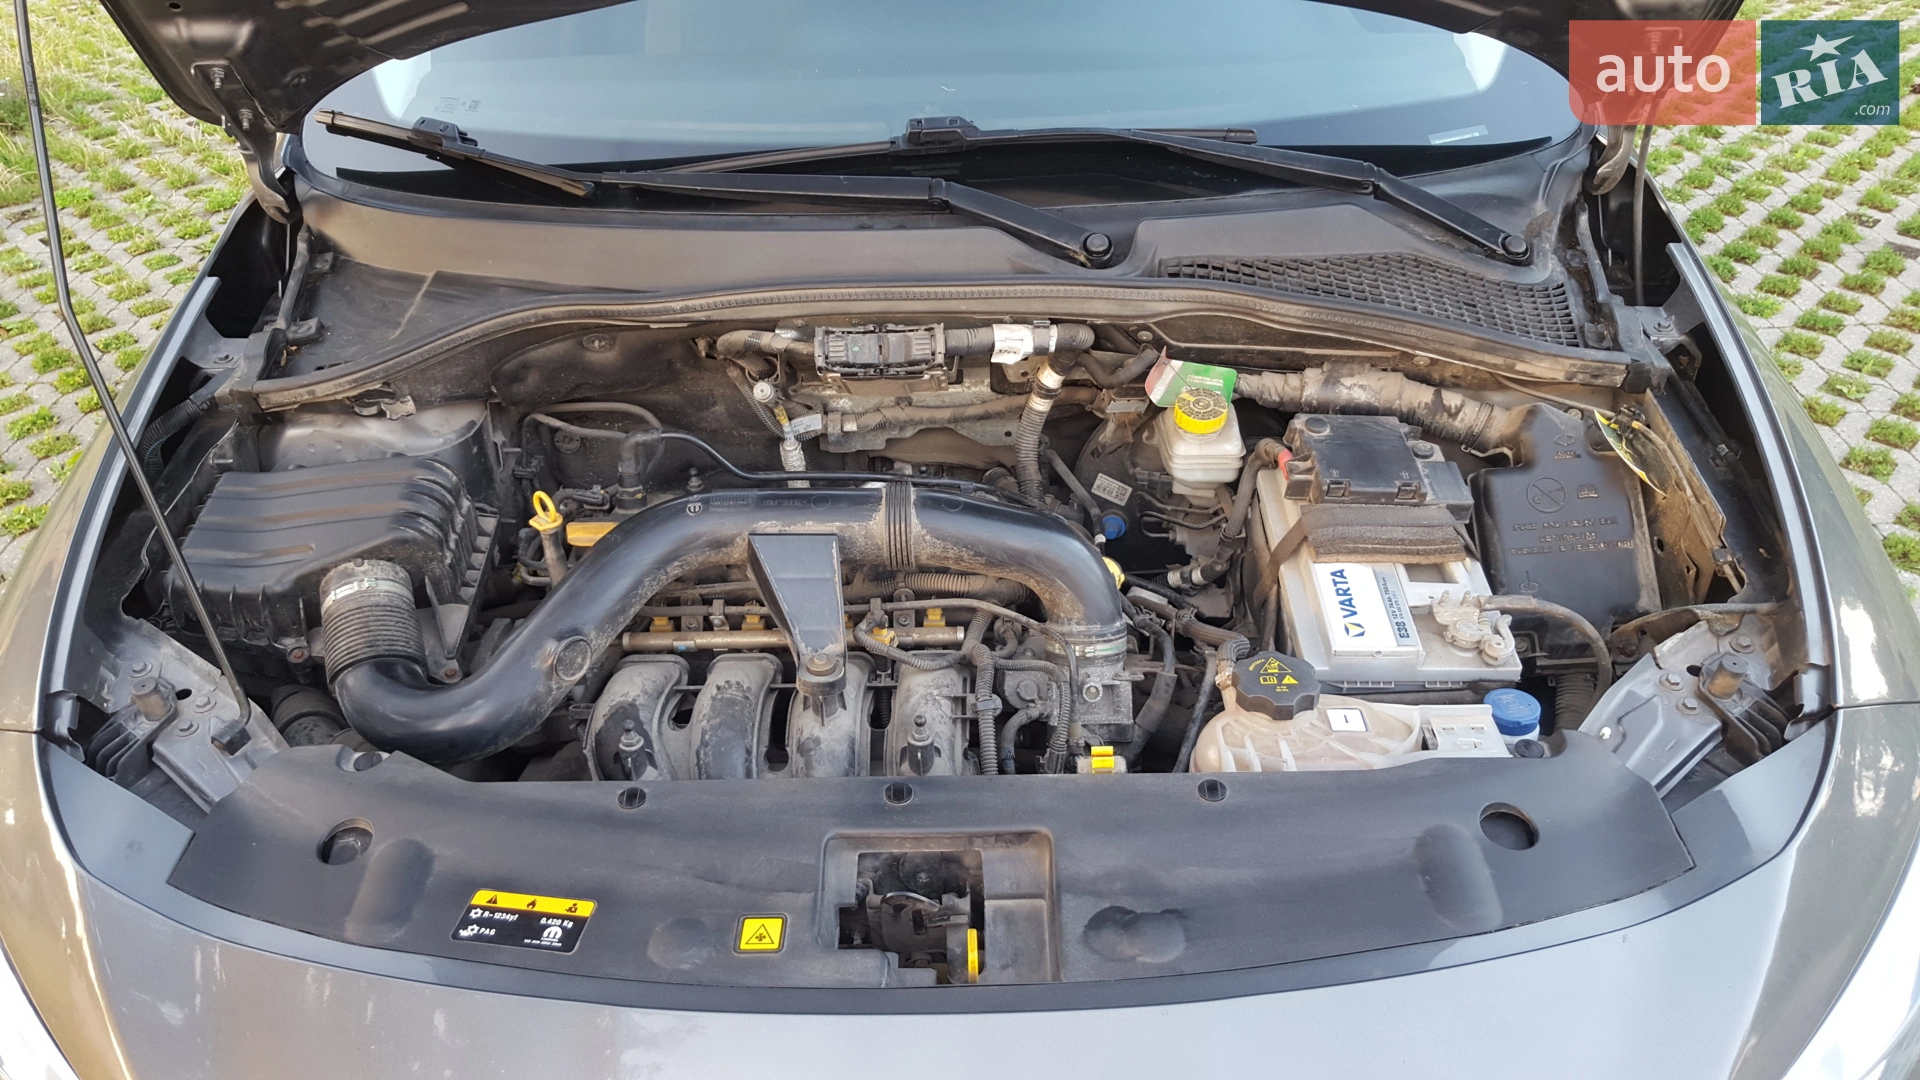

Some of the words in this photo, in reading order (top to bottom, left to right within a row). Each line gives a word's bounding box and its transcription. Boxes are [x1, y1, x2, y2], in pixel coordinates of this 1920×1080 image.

[1330, 568, 1358, 619] VARTA
[1395, 621, 1410, 639] E38
[483, 911, 519, 922] R-1234yf
[540, 917, 562, 926] 0.420
[563, 917, 574, 928] Kg
[478, 927, 496, 935] PAG
